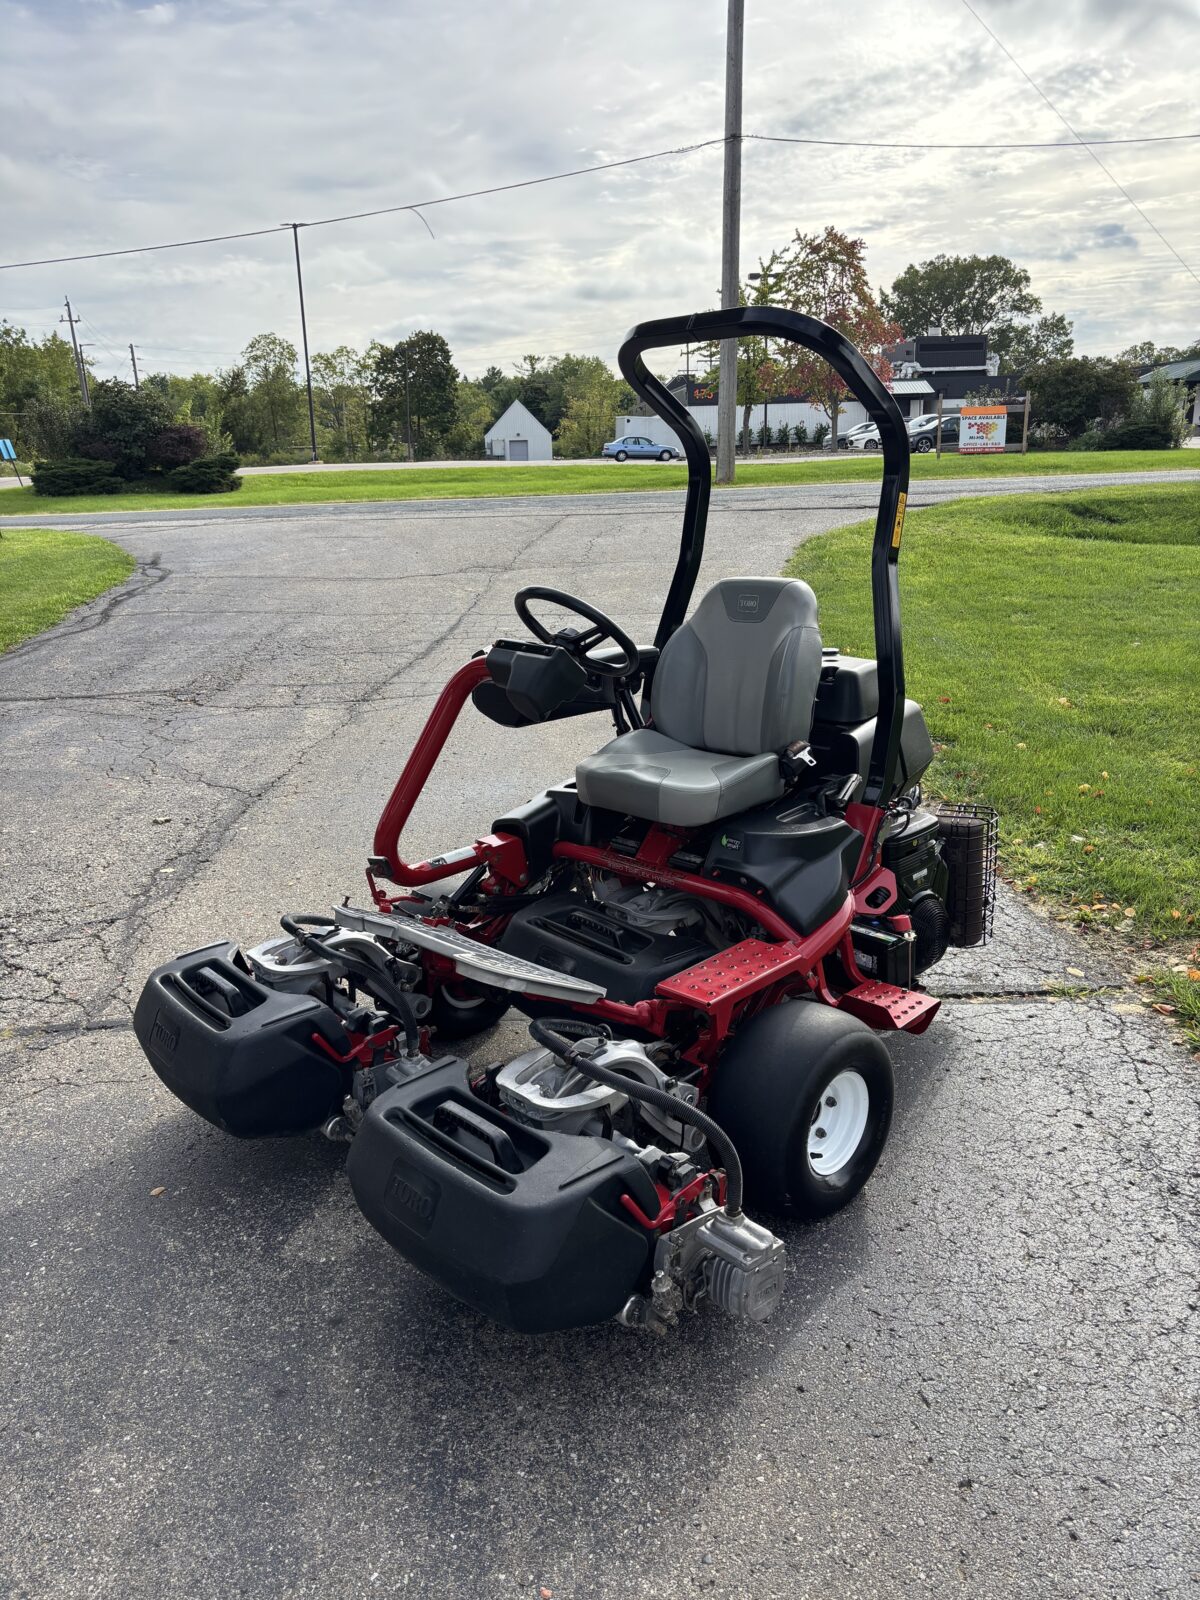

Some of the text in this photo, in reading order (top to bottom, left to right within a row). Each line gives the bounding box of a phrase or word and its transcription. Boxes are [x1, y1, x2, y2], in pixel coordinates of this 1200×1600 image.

[740, 599, 757, 608] TORO
[154, 1020, 176, 1051] TORO
[392, 1173, 433, 1218] TORO
